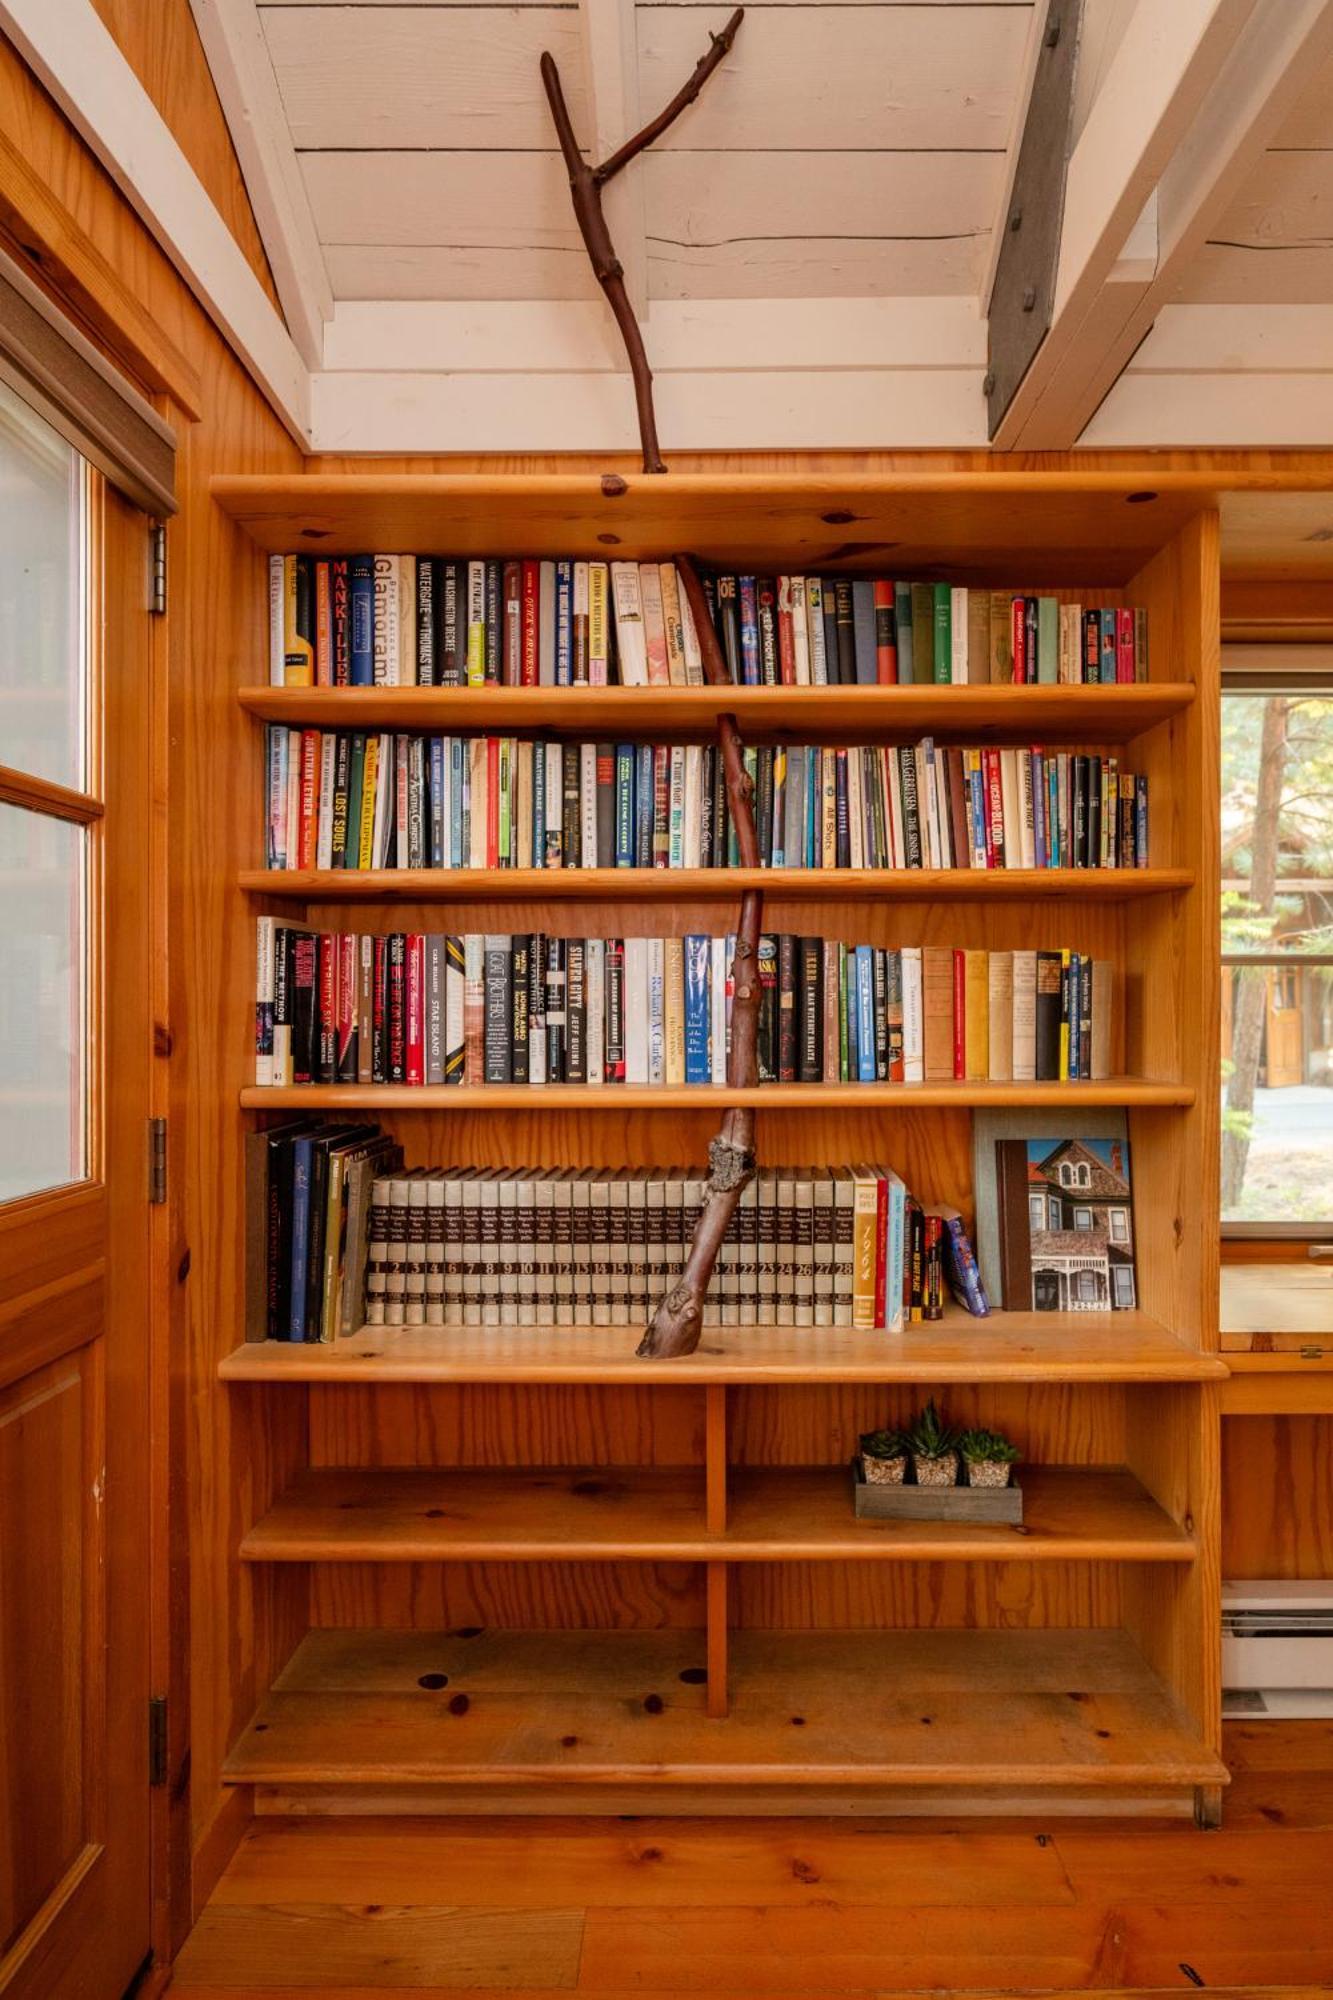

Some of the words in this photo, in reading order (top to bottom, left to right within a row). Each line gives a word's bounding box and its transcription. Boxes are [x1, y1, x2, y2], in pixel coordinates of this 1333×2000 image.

[445, 566, 456, 578] THE
[473, 568, 482, 579] MY
[419, 562, 432, 614] WATERGATE
[445, 580, 456, 625] WASHINGTON
[525, 597, 534, 625] QUICK
[334, 561, 348, 688] MANKILLER
[419, 628, 432, 664] THOMAS
[445, 626, 456, 652] DECREE
[764, 633, 774, 661] MOON
[525, 628, 534, 676] DARKNESS
[304, 736, 314, 780] JONATHAN
[901, 748, 914, 767] TESS
[303, 782, 314, 816] LETHEM
[410, 779, 421, 813] AGATHA
[902, 767, 917, 811] GERRITSEN
[990, 784, 1001, 809] OCEAN
[335, 793, 347, 817] LOST
[991, 811, 1003, 845] BLOOD
[1026, 808, 1034, 830] TIGER
[333, 819, 345, 853] SOULS
[824, 822, 835, 851] Shots
[907, 833, 919, 861] SINNER
[641, 836, 650, 861] RIDERS
[489, 952, 505, 976] GOAT
[520, 950, 528, 974] MARTIN
[569, 946, 583, 981] SILVER
[806, 957, 817, 982] KERR
[323, 965, 332, 1007] TRINITY
[1081, 973, 1091, 995] orphan
[278, 982, 286, 1021] METHOW
[487, 977, 508, 1018] BROTHERS
[520, 991, 528, 1017] LIONEL
[537, 987, 545, 1013] PEACE
[569, 984, 583, 1009] CITY
[651, 976, 662, 1016] Richard
[323, 1010, 332, 1026] SIX
[391, 1004, 402, 1019] ON
[431, 1000, 440, 1022] STAR
[611, 1004, 618, 1013] OF
[519, 1019, 528, 1041] ASBO
[571, 1013, 580, 1034] JEFF
[807, 1007, 815, 1035] WITHOUT
[327, 1032, 335, 1063] CHARLES
[431, 1023, 440, 1056] ISLAND
[571, 1037, 580, 1065] GUINN
[651, 1033, 661, 1067] Clarke
[391, 1040, 405, 1065] EDGE
[861, 1225, 872, 1281] 1964
[375, 1263, 381, 1274] 1
[392, 1263, 401, 1274] 2
[413, 1263, 421, 1274] 3
[430, 1263, 439, 1274] 4
[448, 1263, 457, 1274] 6
[466, 1263, 476, 1274] 7
[485, 1263, 494, 1274] 8
[503, 1263, 513, 1275] 9
[520, 1263, 533, 1275] 10
[539, 1263, 550, 1275] 11
[557, 1263, 571, 1275] 12
[576, 1263, 589, 1275] 13
[594, 1263, 608, 1275] 14
[612, 1263, 625, 1275] 15
[632, 1263, 644, 1275] 16
[651, 1263, 663, 1275] 17
[668, 1263, 680, 1275] 18
[725, 1263, 737, 1275] 21
[741, 1263, 755, 1275] 22
[759, 1263, 775, 1275] 23
[777, 1263, 794, 1275] 24
[797, 1264, 812, 1276] 26
[816, 1263, 831, 1275] 27
[837, 1263, 852, 1275] 28
[912, 1261, 920, 1275] SAFE
[912, 1275, 921, 1292] PLACE
